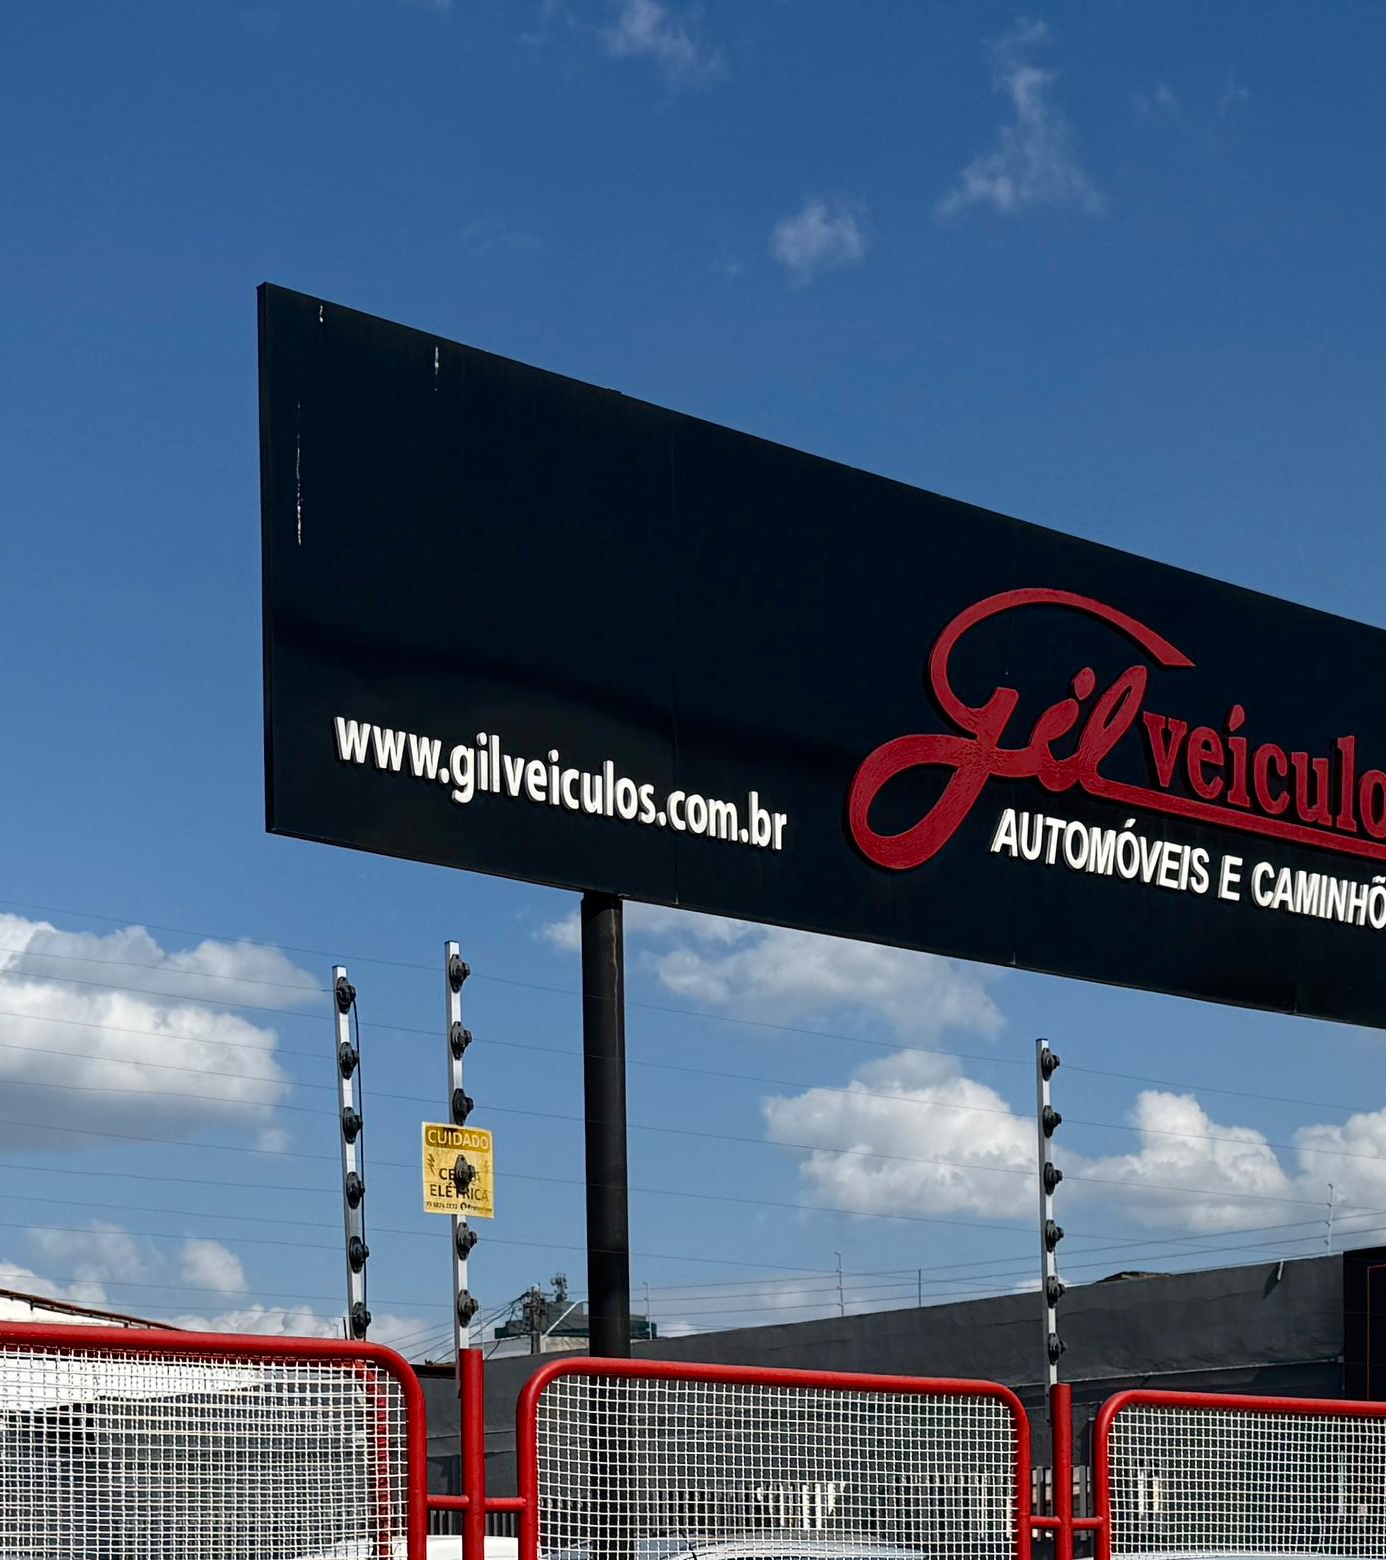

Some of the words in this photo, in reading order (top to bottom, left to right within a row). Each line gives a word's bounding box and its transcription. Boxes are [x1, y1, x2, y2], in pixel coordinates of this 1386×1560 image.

[850, 587, 1195, 869] Gil
[332, 716, 788, 851] www.gilveiculos.com.br
[990, 808, 1209, 894] AUTOMÓVEIS
[1217, 854, 1244, 902] E
[427, 1129, 490, 1150] CUIDADO
[438, 1168, 481, 1183] CEA
